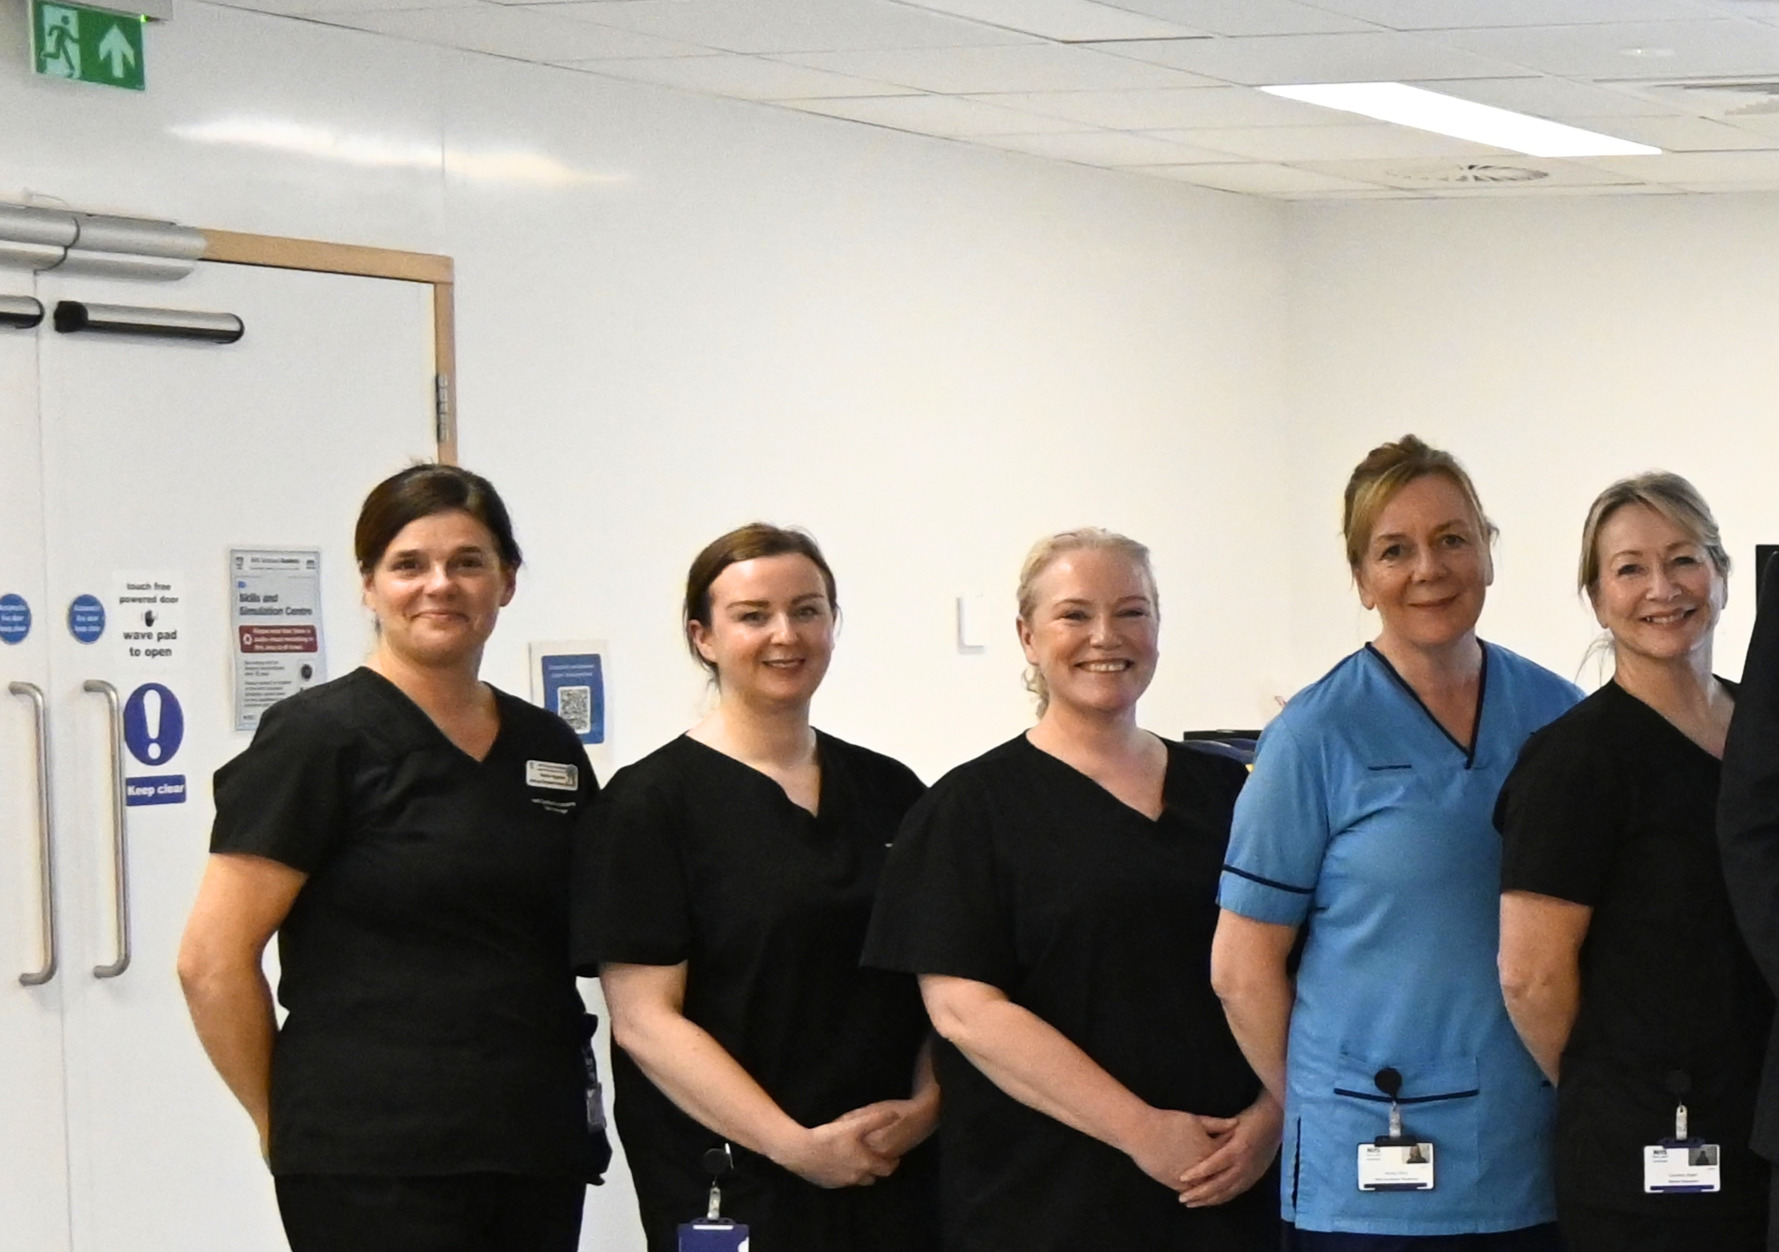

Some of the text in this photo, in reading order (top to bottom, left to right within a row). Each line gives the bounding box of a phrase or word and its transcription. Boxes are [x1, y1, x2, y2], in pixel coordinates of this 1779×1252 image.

[119, 595, 179, 605] powered door
[262, 594, 279, 603] and
[123, 629, 177, 642] wave pad
[129, 646, 172, 659] to open
[128, 784, 184, 797] Keep clear
